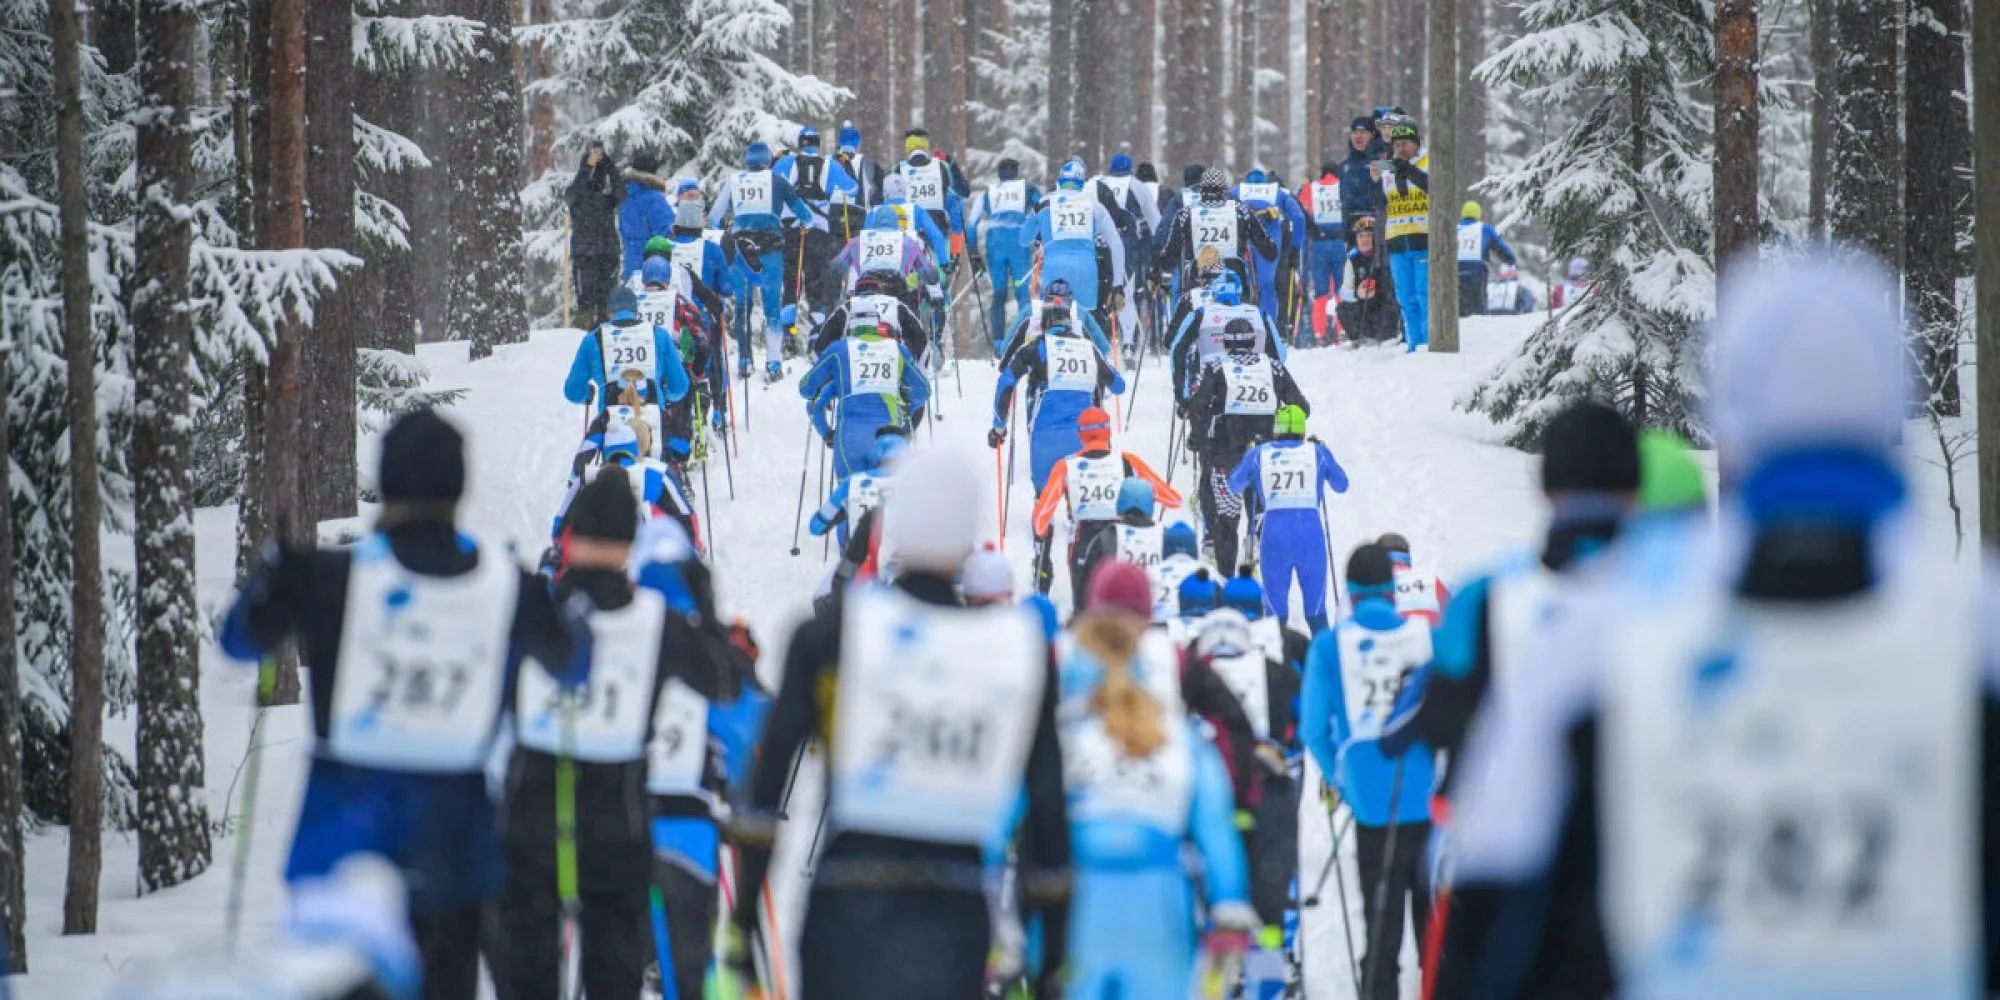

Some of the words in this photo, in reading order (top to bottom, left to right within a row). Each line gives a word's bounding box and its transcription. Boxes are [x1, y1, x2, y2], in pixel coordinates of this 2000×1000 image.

[739, 187, 764, 201] 191
[1058, 212, 1086, 227] 212
[1200, 227, 1231, 243] 224
[866, 243, 894, 258] 203
[613, 346, 647, 364] 230
[859, 362, 891, 380] 278
[1056, 357, 1088, 374] 201
[1235, 385, 1269, 403] 226
[1271, 471, 1306, 490] 271
[1079, 484, 1115, 503] 246
